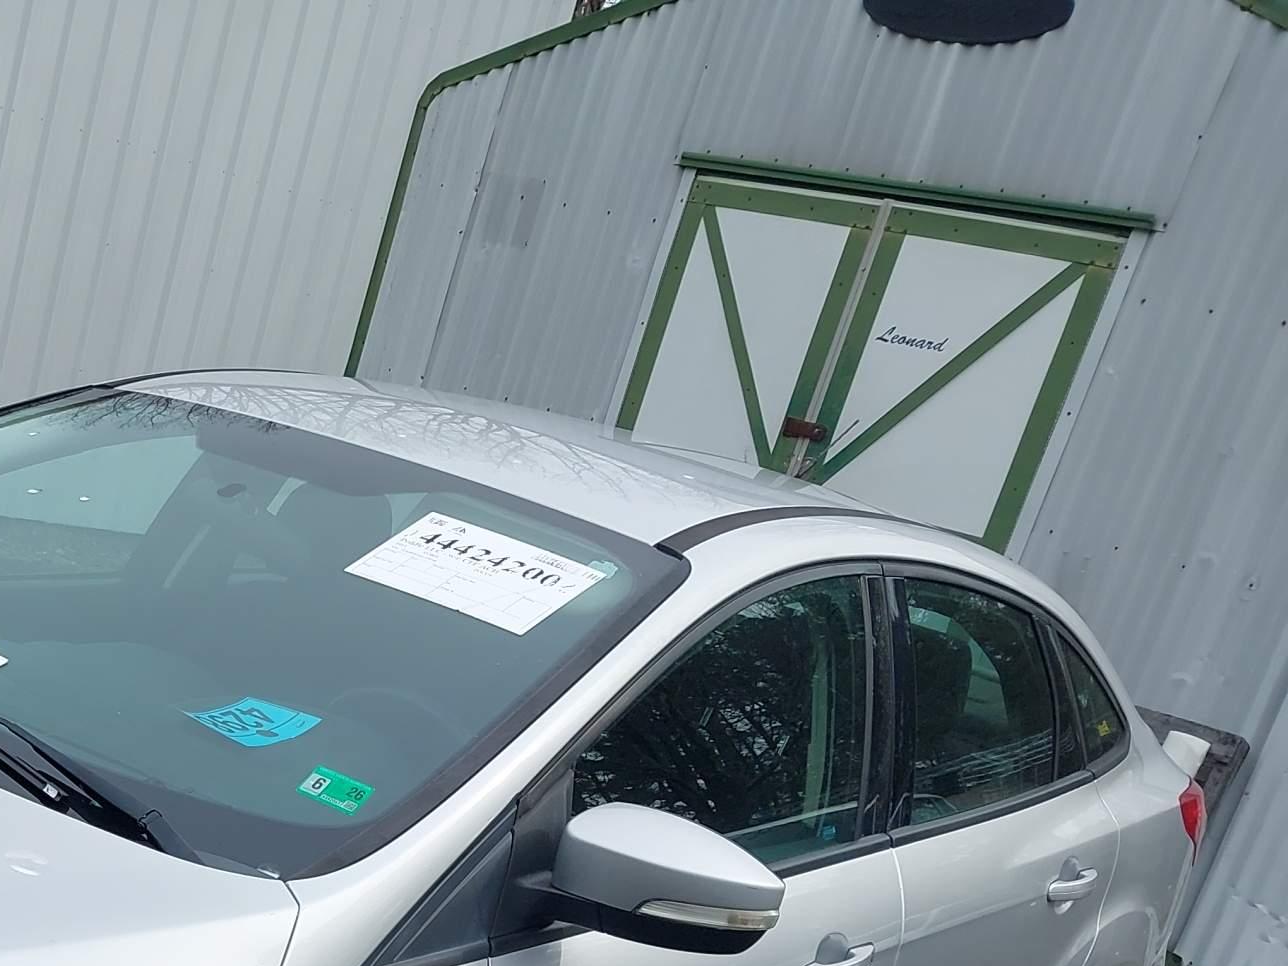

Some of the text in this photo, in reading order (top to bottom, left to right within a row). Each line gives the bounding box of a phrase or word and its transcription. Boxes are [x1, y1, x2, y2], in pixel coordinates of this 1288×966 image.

[875, 326, 950, 352] Leonard
[420, 533, 561, 587] 44424200
[312, 777, 327, 790] 6
[346, 787, 367, 801] 26
